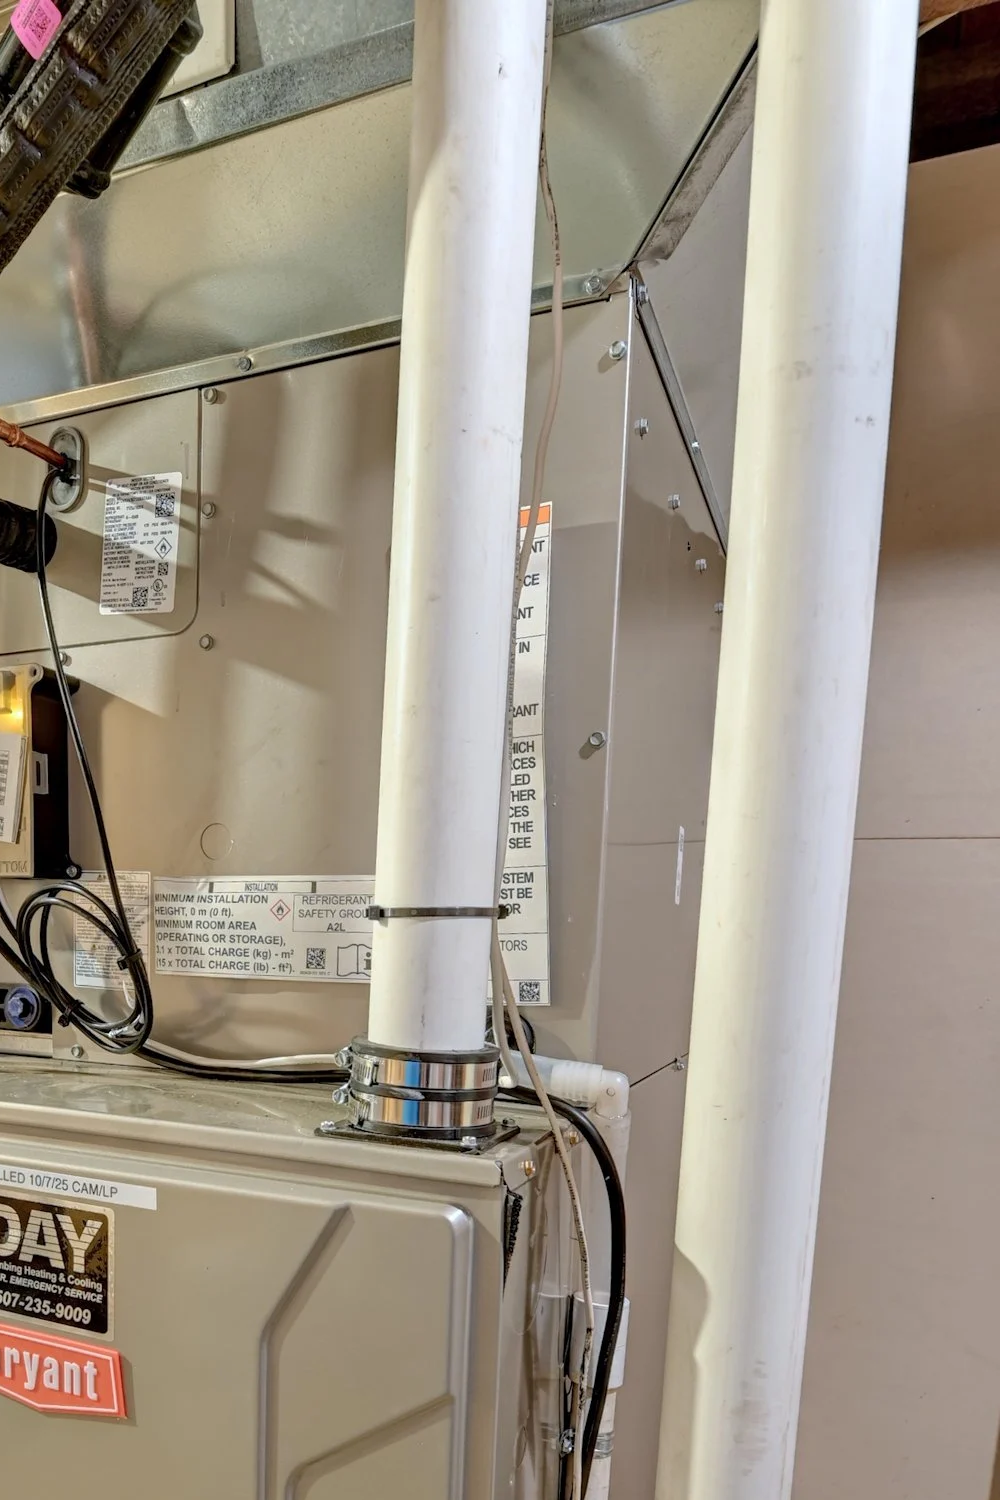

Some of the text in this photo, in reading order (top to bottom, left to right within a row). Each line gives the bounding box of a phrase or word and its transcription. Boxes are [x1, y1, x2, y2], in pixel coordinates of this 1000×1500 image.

[530, 540, 545, 552] NT
[524, 574, 540, 586] CE
[518, 606, 534, 619] NT
[511, 821, 533, 833] THE
[509, 837, 531, 849] SEE
[502, 872, 534, 884] STEM
[244, 883, 278, 891] INSTALLATION
[155, 893, 268, 903] MINIMUM INSTALLATION
[500, 888, 532, 899] ST BE
[302, 896, 373, 905] REFRIGERANT
[155, 906, 188, 916] HEIGHT,
[210, 908, 218, 918] (0
[221, 908, 234, 918] ft).
[298, 909, 368, 918] SAFETY GROU
[507, 904, 521, 915] OR
[155, 920, 256, 930] MINIMUM ROOM AREA
[327, 923, 346, 932] A2L
[156, 933, 286, 946] (OPERATING OR STORAGE),
[500, 940, 528, 951] TORS
[175, 946, 205, 955] TOTAL
[208, 947, 250, 957] CHARGE
[253, 949, 271, 960] (kg)
[157, 958, 166, 968] (15
[175, 959, 205, 968] TOTAL
[208, 960, 250, 970] CHARGE
[253, 962, 269, 973] (lb)
[30, 1174, 69, 1191] 10/7/25
[72, 1181, 118, 1198] CAM/LP
[24, 1266, 56, 1283] Heating
[59, 1273, 66, 1283] &
[67, 1274, 103, 1292] Cooling
[10, 1275, 64, 1295] EMERGENCY
[64, 1288, 103, 1304] SERVICE
